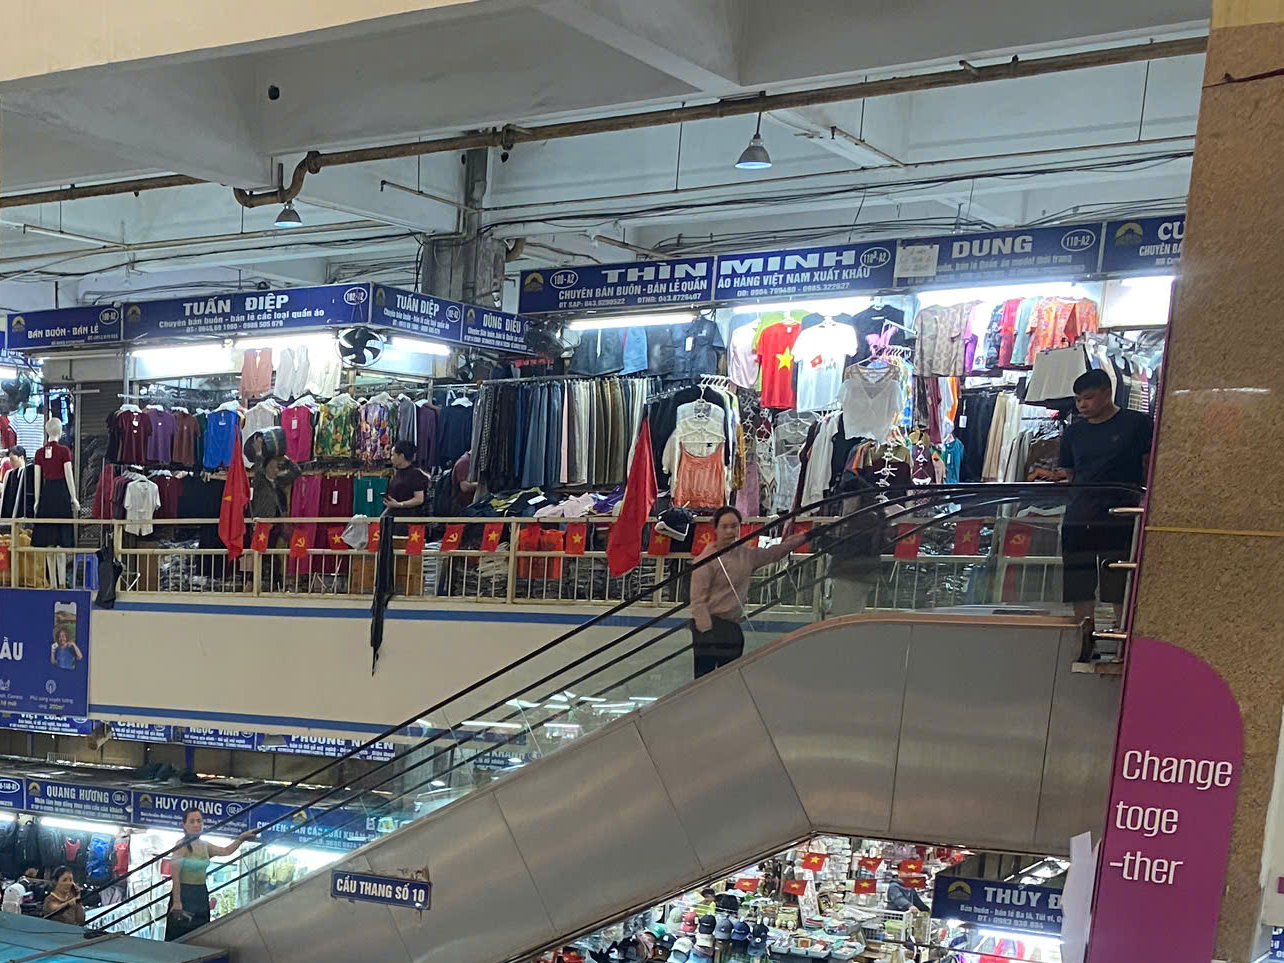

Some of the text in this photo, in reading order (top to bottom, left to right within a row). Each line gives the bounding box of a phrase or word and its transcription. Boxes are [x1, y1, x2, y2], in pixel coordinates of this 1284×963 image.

[951, 235, 1033, 258] DUNG
[601, 262, 707, 283] THÌN
[720, 250, 856, 275] MINH
[559, 288, 593, 300] CHUYÊN
[616, 284, 641, 296] BUÔN
[681, 278, 707, 292] QUẦN
[718, 276, 730, 289] ÁO
[734, 274, 760, 288] HÀNG
[763, 272, 784, 287] VIỆT
[786, 272, 810, 283] NAM
[813, 267, 839, 282] XUẤT
[183, 293, 289, 316] TUẤN ĐIỆP
[396, 294, 419, 312] TUẤN
[188, 316, 202, 326] bán
[204, 315, 223, 325] buôn
[230, 314, 244, 323] bán
[257, 311, 272, 321] các
[273, 310, 289, 320] loại
[291, 308, 312, 319] quần
[313, 306, 324, 317] áo
[28, 328, 43, 339] BÁN
[1122, 750, 1233, 791] Change
[46, 785, 109, 803] QUANG HƯƠNG
[155, 796, 178, 811] HUY
[1116, 801, 1179, 837] toge
[1109, 851, 1184, 885] -ther
[336, 874, 425, 902] CẦU THANG SỐ 10
[984, 885, 1042, 908] THỦY
